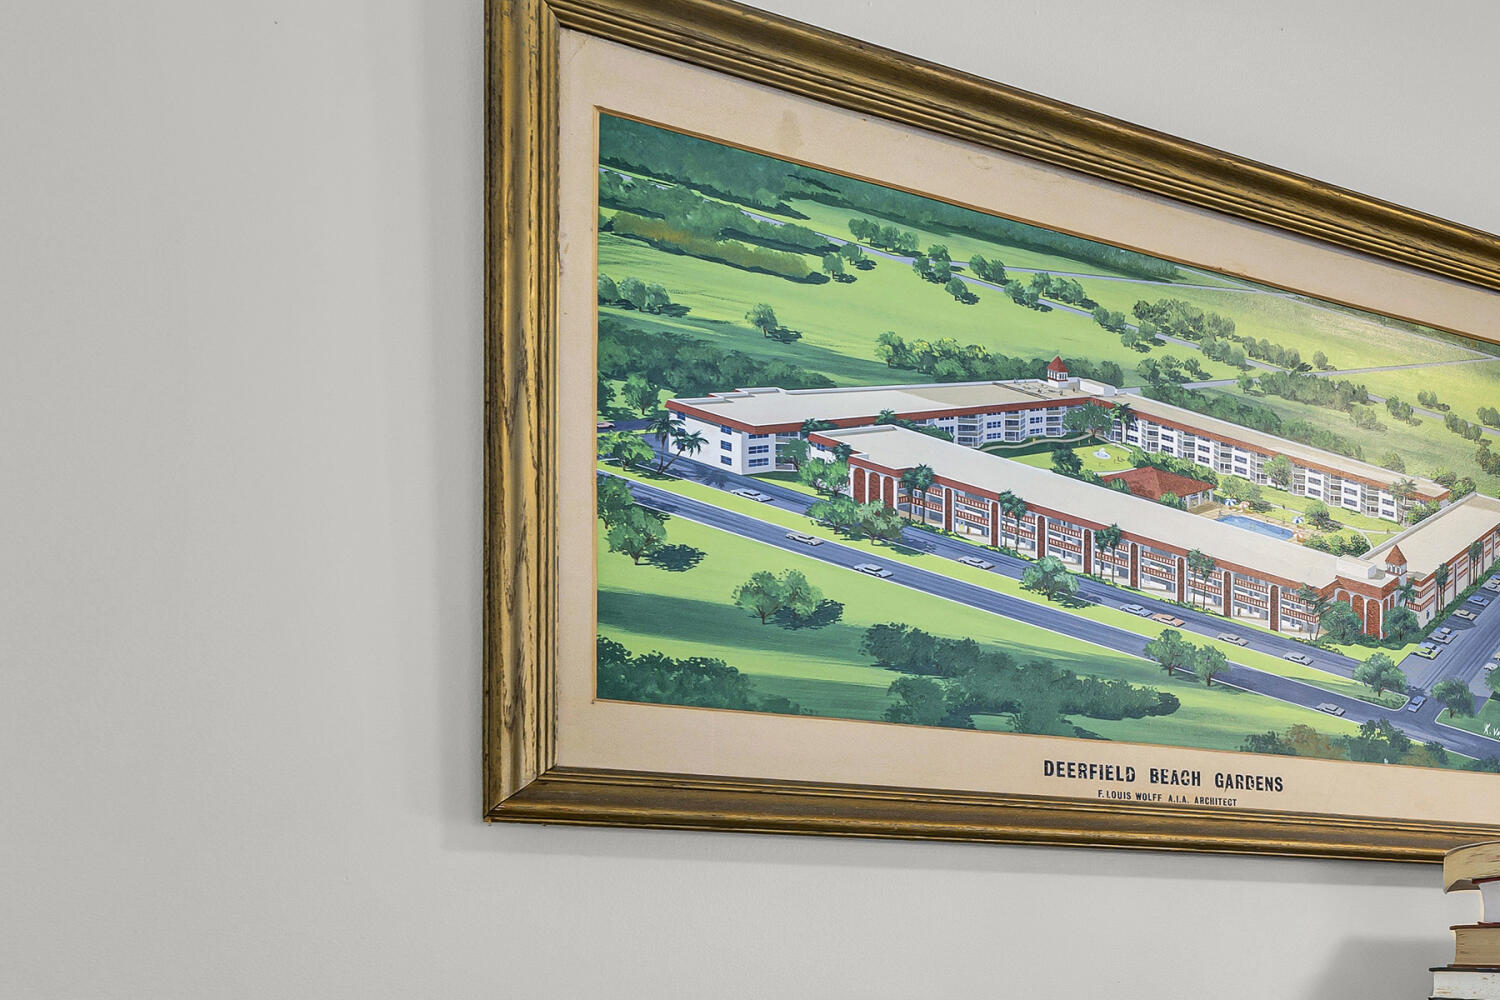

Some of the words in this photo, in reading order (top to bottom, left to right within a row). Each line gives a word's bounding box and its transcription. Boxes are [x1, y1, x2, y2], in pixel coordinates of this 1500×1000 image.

[1044, 759, 1136, 782] DEERFIELD
[1150, 769, 1201, 787] BEACH
[1215, 774, 1283, 793] GARDENS
[1106, 790, 1132, 801] LOUIS
[1136, 793, 1162, 803] WOLFF
[1194, 796, 1238, 807] ARCHITECT
